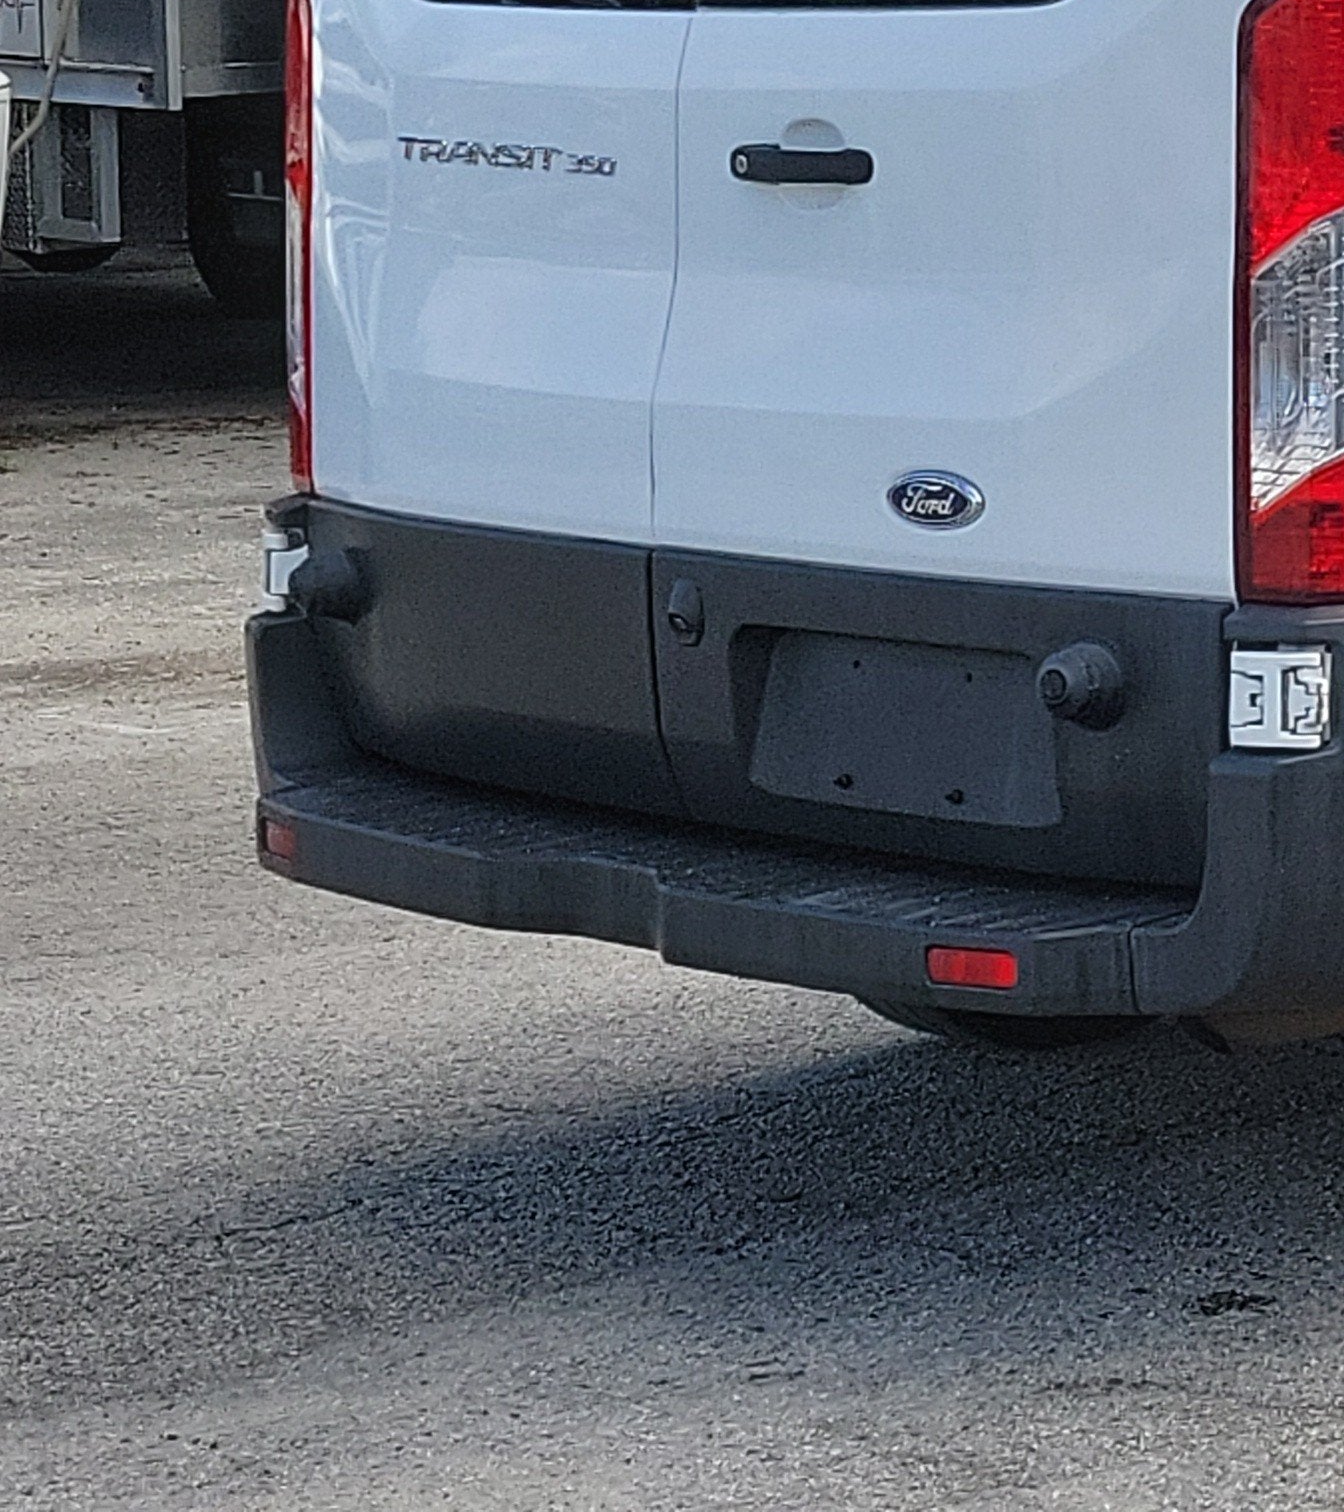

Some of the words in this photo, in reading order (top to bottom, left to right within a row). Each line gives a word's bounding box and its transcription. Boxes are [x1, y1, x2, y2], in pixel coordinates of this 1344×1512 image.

[398, 137, 564, 171] TRANSIT
[565, 152, 618, 176] 350
[901, 483, 955, 516] Ford
